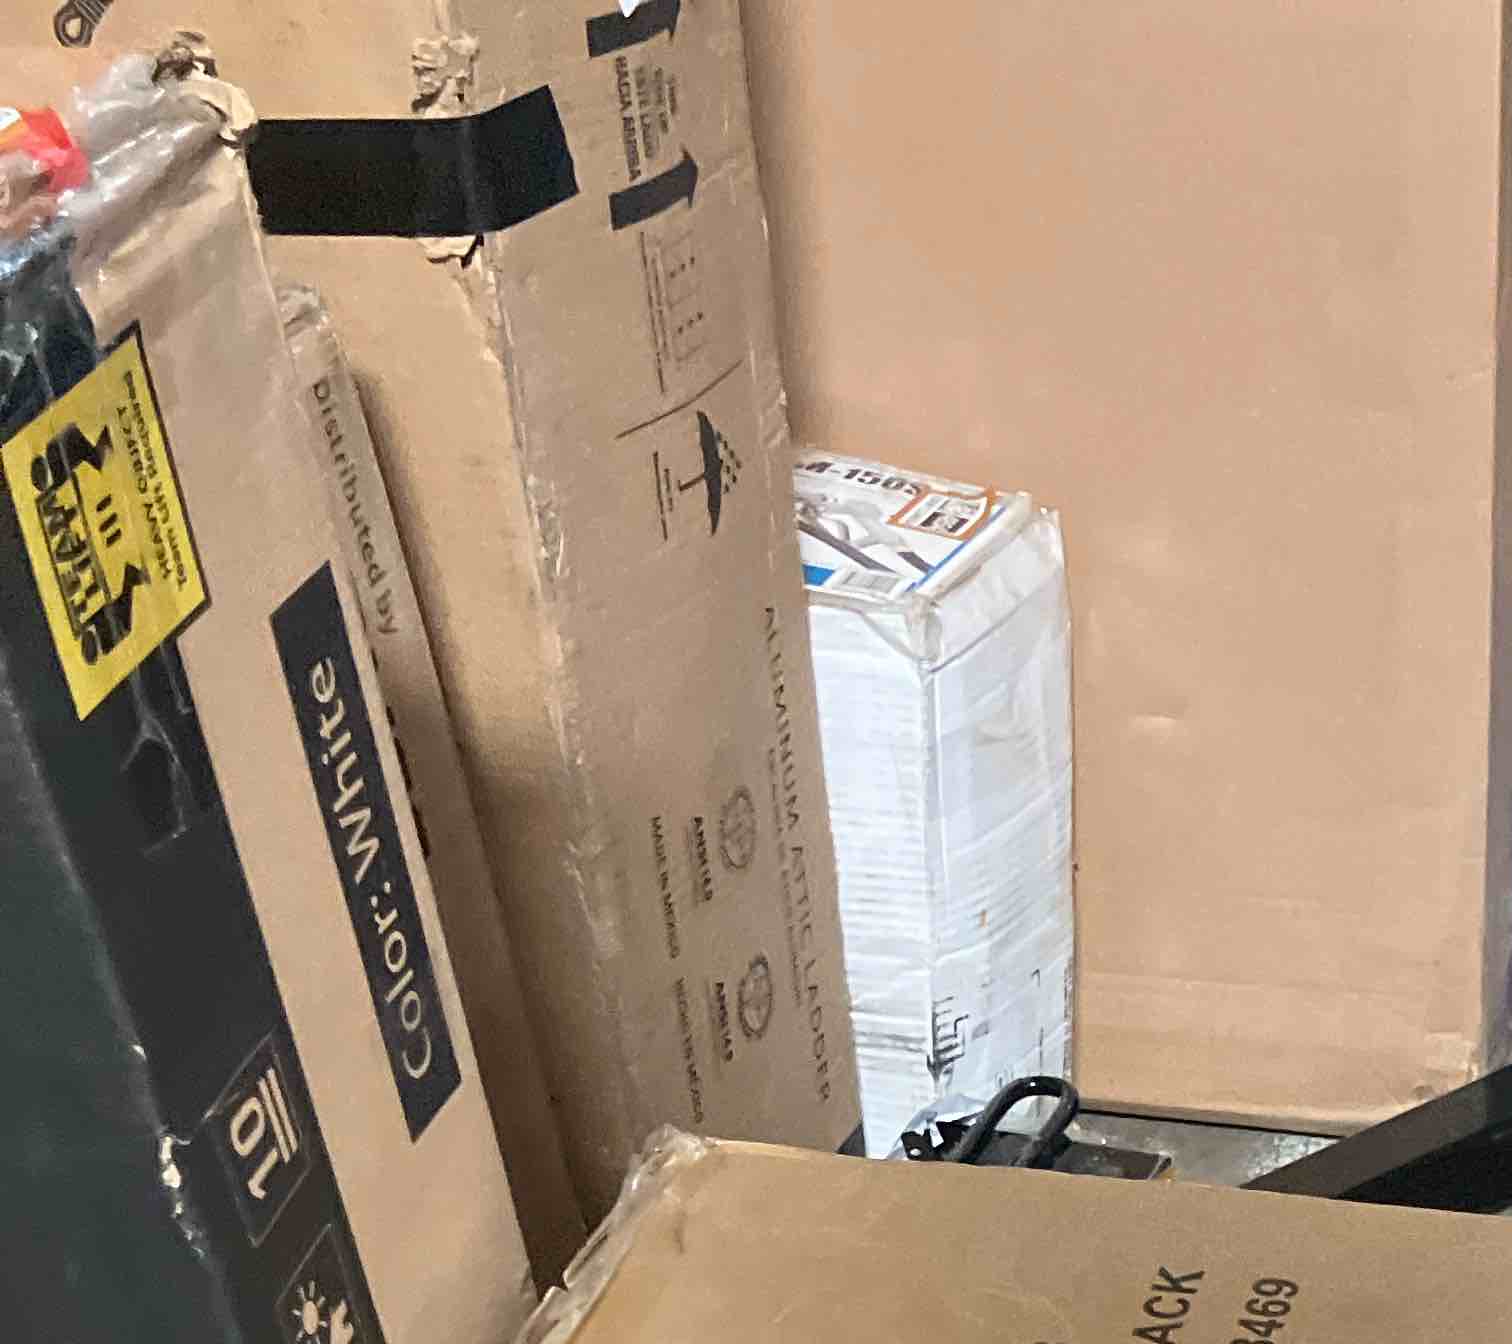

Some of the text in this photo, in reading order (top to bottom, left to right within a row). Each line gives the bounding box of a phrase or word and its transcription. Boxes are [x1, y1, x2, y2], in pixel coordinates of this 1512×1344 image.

[116, 405, 171, 580] HEAVY OBJECT
[124, 370, 187, 592] Team Lift Required
[310, 380, 400, 637] Distributed by
[764, 607, 800, 834] ALUMINUM
[308, 654, 432, 1079] Color: White
[788, 844, 813, 943] ATTIC
[799, 957, 832, 1103] LADDER
[230, 1099, 280, 1200] 10
